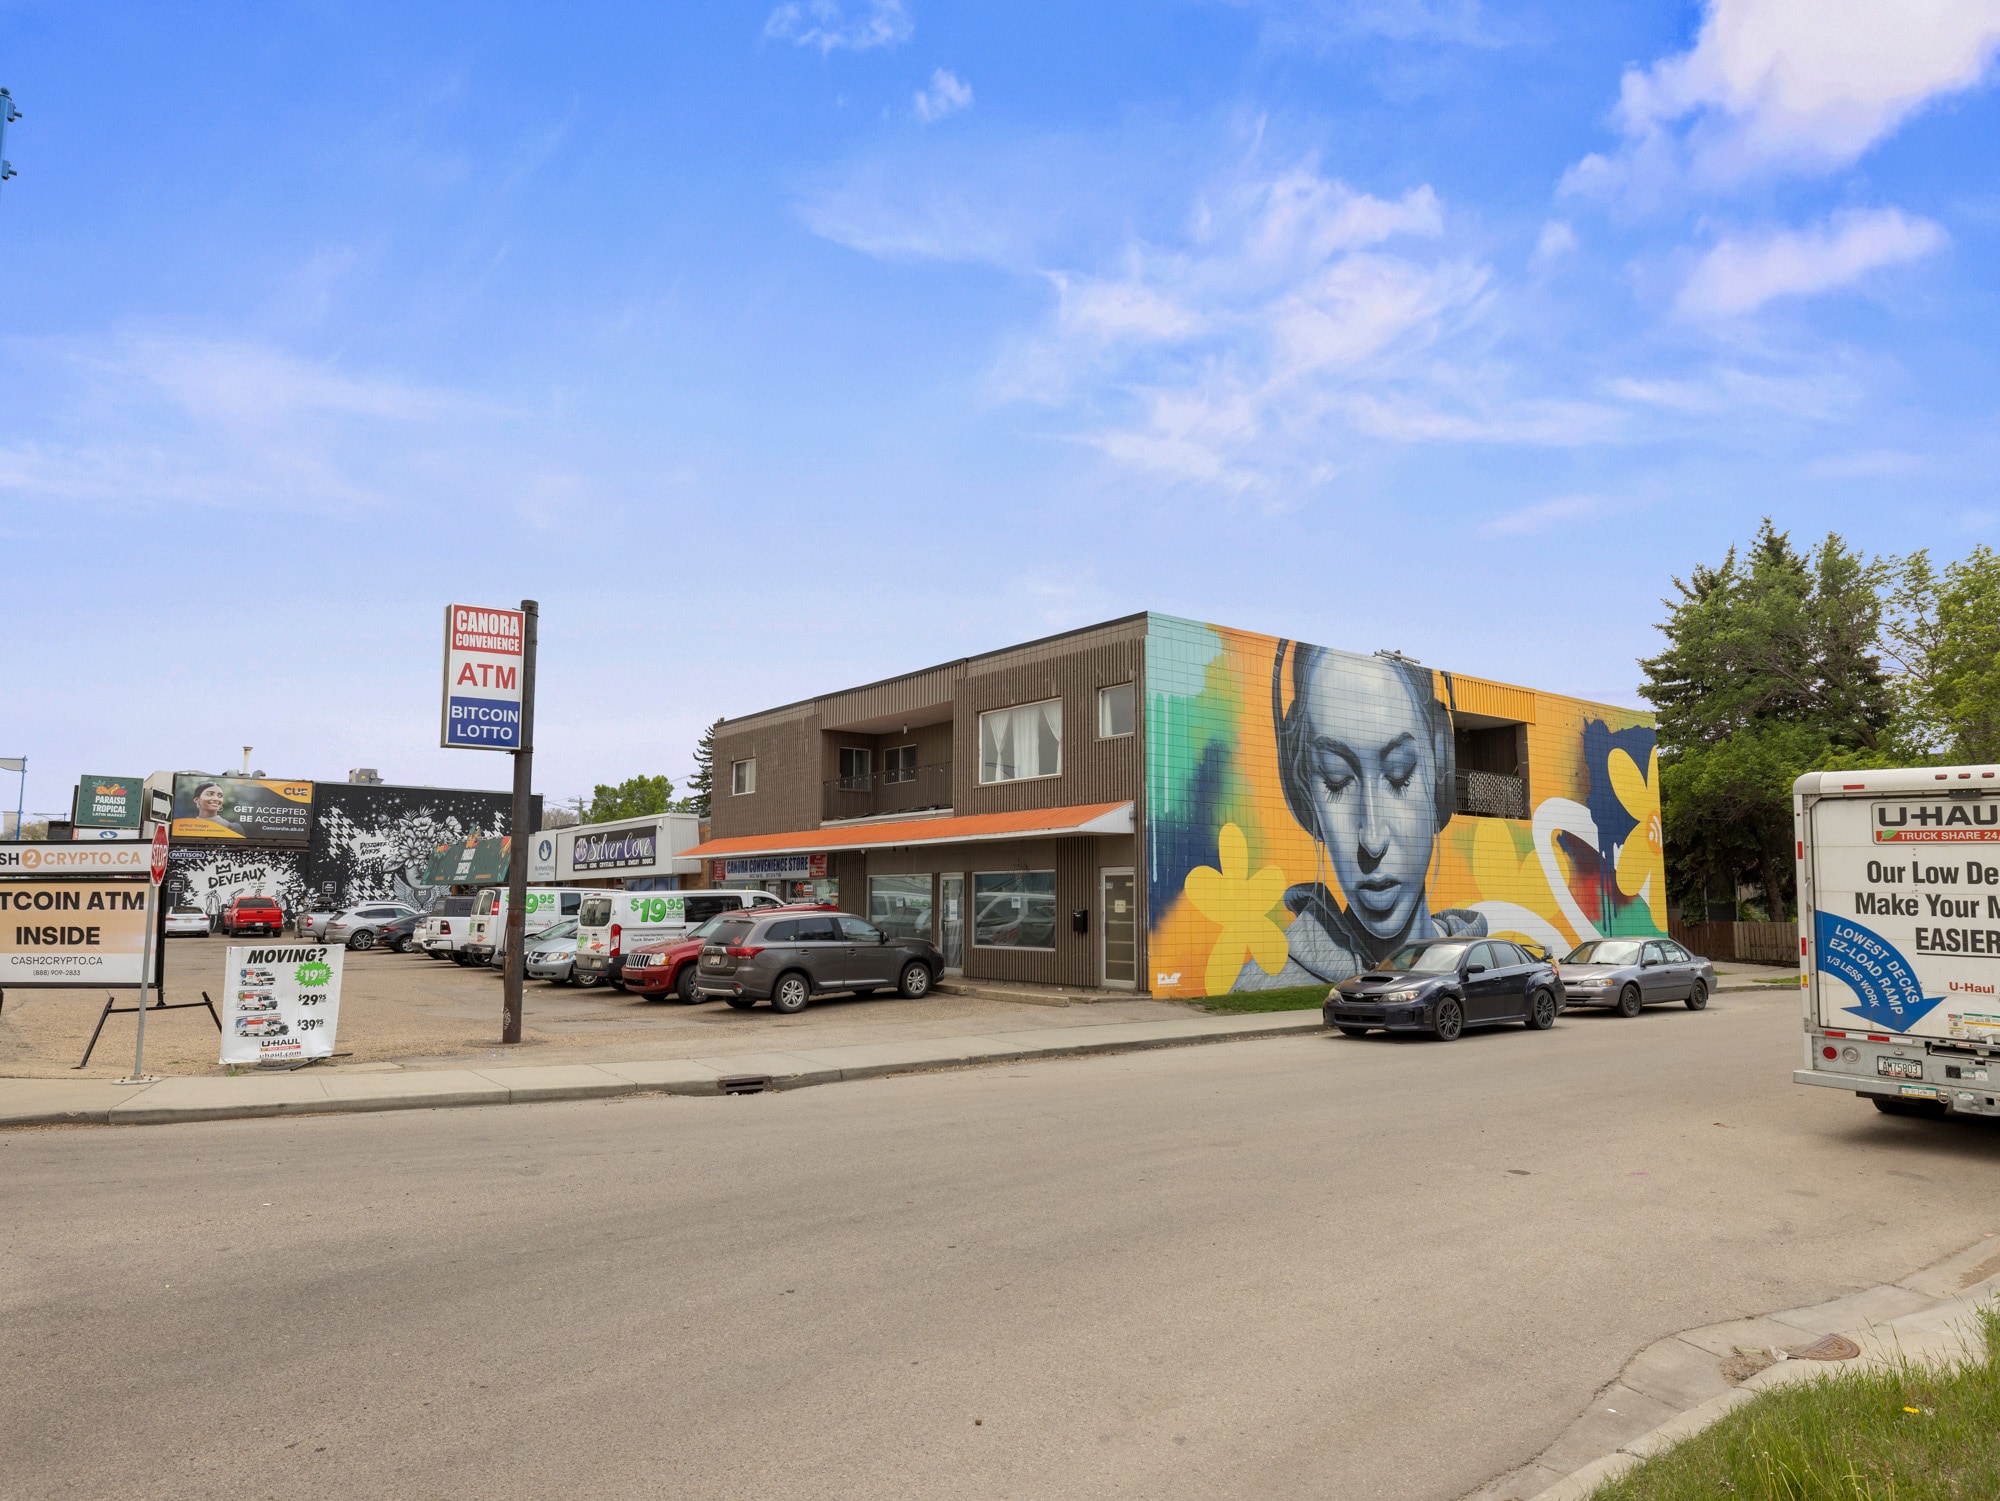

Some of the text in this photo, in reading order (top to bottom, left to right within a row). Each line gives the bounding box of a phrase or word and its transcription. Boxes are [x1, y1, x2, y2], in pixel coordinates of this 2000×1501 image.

[456, 610, 520, 637] CANORA
[455, 633, 520, 652] CONVENIENCE
[457, 662, 517, 690] ATM
[451, 705, 519, 723] BITCOIN
[456, 723, 513, 740] LOTTO
[95, 795, 126, 805] PARAISO
[283, 787, 308, 796] CUE
[92, 804, 127, 814] TROPICAL
[233, 805, 308, 816] GET ACCEPTED.
[240, 815, 307, 825] BE ACCEPTED.
[1901, 831, 2000, 840] TRUCK SHARE 24
[152, 844, 167, 867] STOP
[587, 832, 653, 861] Silver Cove
[749, 857, 787, 873] CONVENIENCE
[788, 857, 808, 871] STORE
[1867, 861, 1906, 883] Our
[1912, 861, 1959, 884] Low
[208, 867, 266, 889] DEVEAUX
[87, 891, 145, 911] ATM
[1855, 892, 1919, 917] Make
[1925, 894, 1980, 918] Your
[16, 926, 100, 945] INSIDE
[1915, 927, 2000, 954] EASIER
[11, 956, 103, 966] CASH2CRYPTO.CA
[247, 948, 328, 964] MOVING?
[1835, 924, 1920, 1004] LOWEST DECKS
[1826, 955, 1880, 1008] 1/3 LESS WORK
[1829, 938, 1904, 1015] EZ-LOAD RAMP
[1949, 982, 1995, 994] U-Haul
[260, 1051, 302, 1059] uhaul.com
